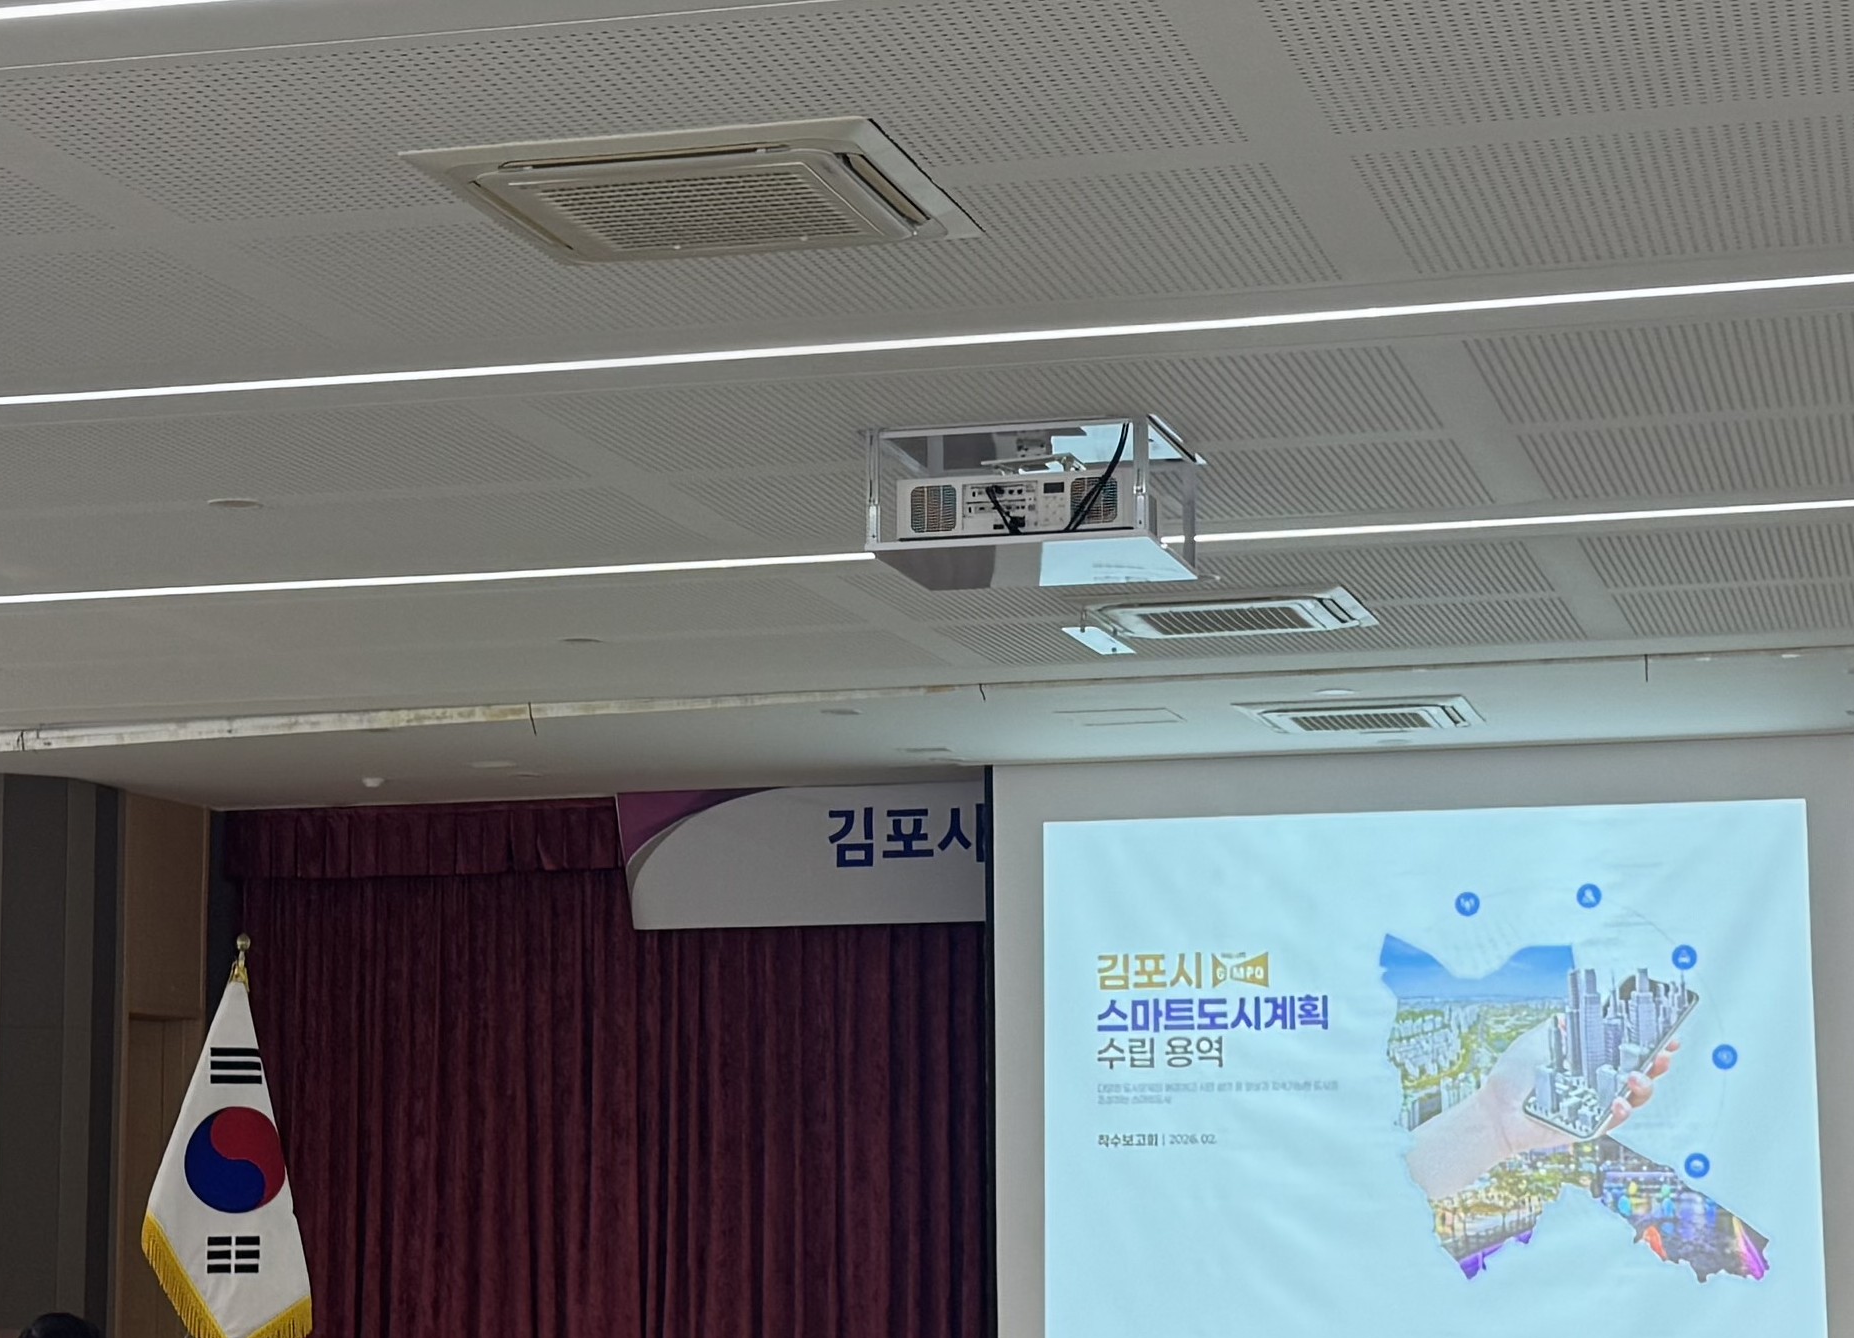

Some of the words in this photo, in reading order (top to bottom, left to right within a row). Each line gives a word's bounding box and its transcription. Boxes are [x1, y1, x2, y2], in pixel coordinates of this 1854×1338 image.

[828, 801, 985, 868] 김포시
[1097, 952, 1202, 990] 김포시
[1097, 994, 1329, 1032] 스마트도시계획
[1097, 1037, 1156, 1070] 수립
[1165, 1036, 1224, 1068] 용역
[1098, 1133, 1158, 1147] 착수보고회
